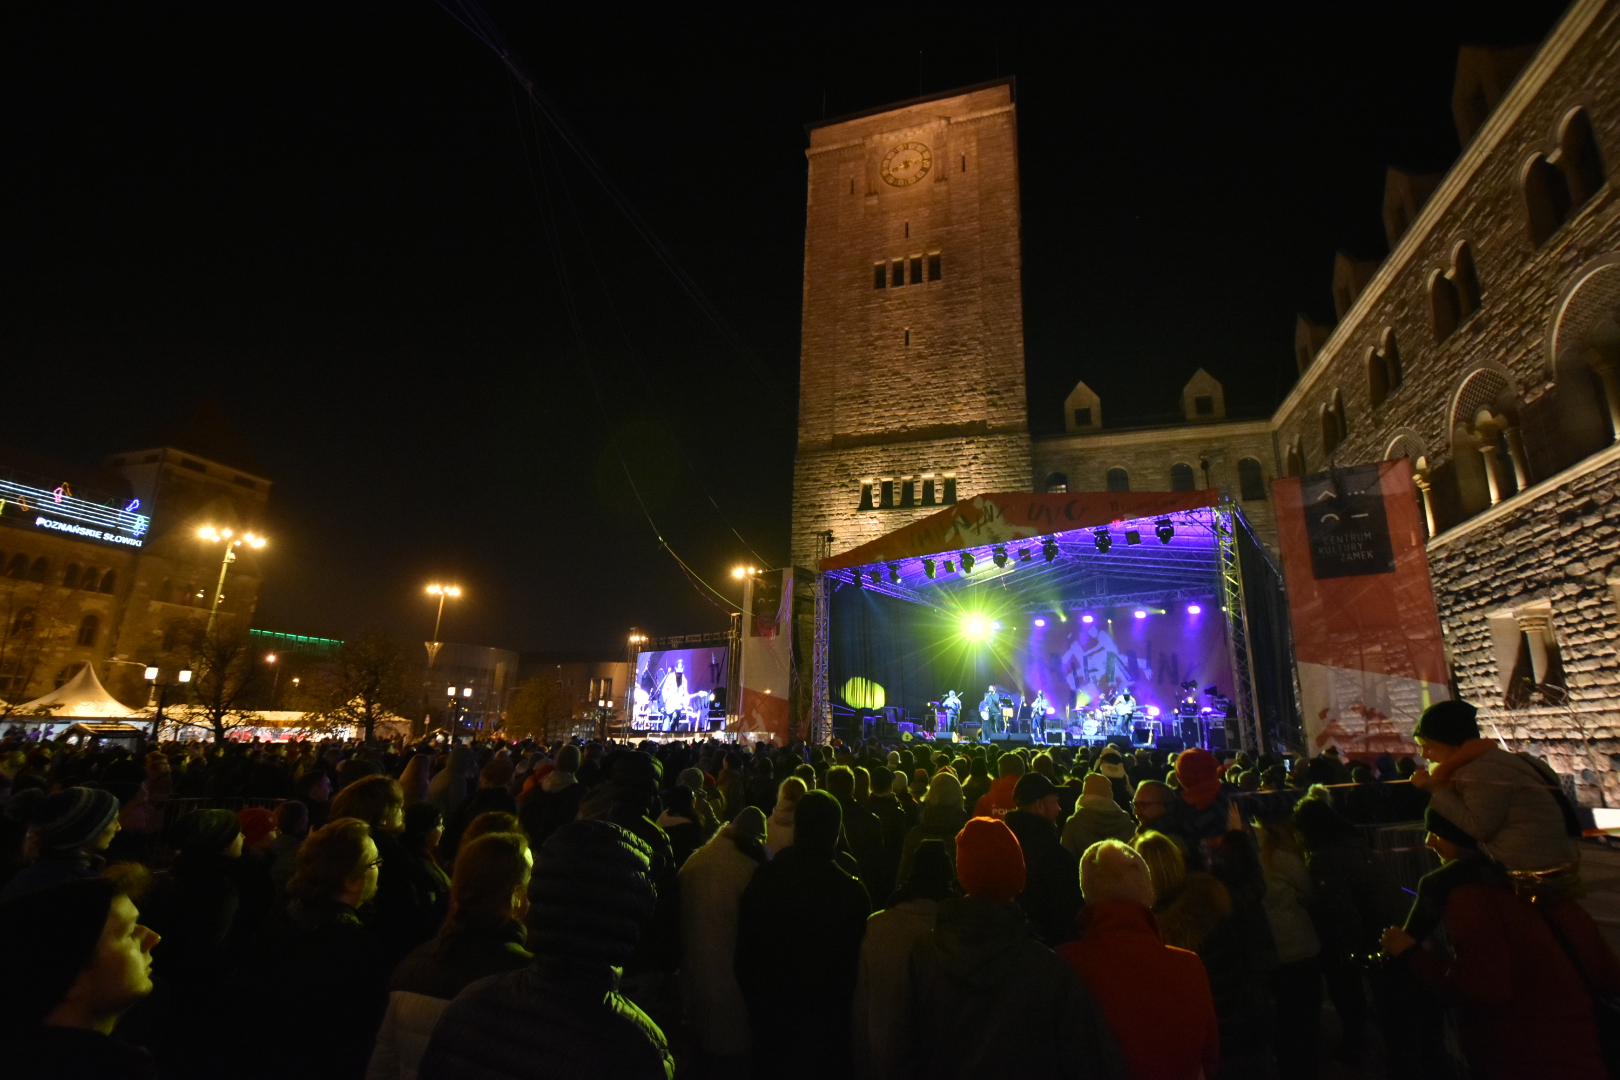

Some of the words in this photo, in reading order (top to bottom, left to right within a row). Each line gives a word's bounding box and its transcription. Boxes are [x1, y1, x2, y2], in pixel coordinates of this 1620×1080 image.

[36, 516, 104, 539] POZNAŃSKIE
[102, 532, 143, 548] SŁOWIKI
[1323, 531, 1372, 545] CENTRUM
[1318, 542, 1363, 555] KULTURY
[1340, 549, 1374, 562] ZAMEK
